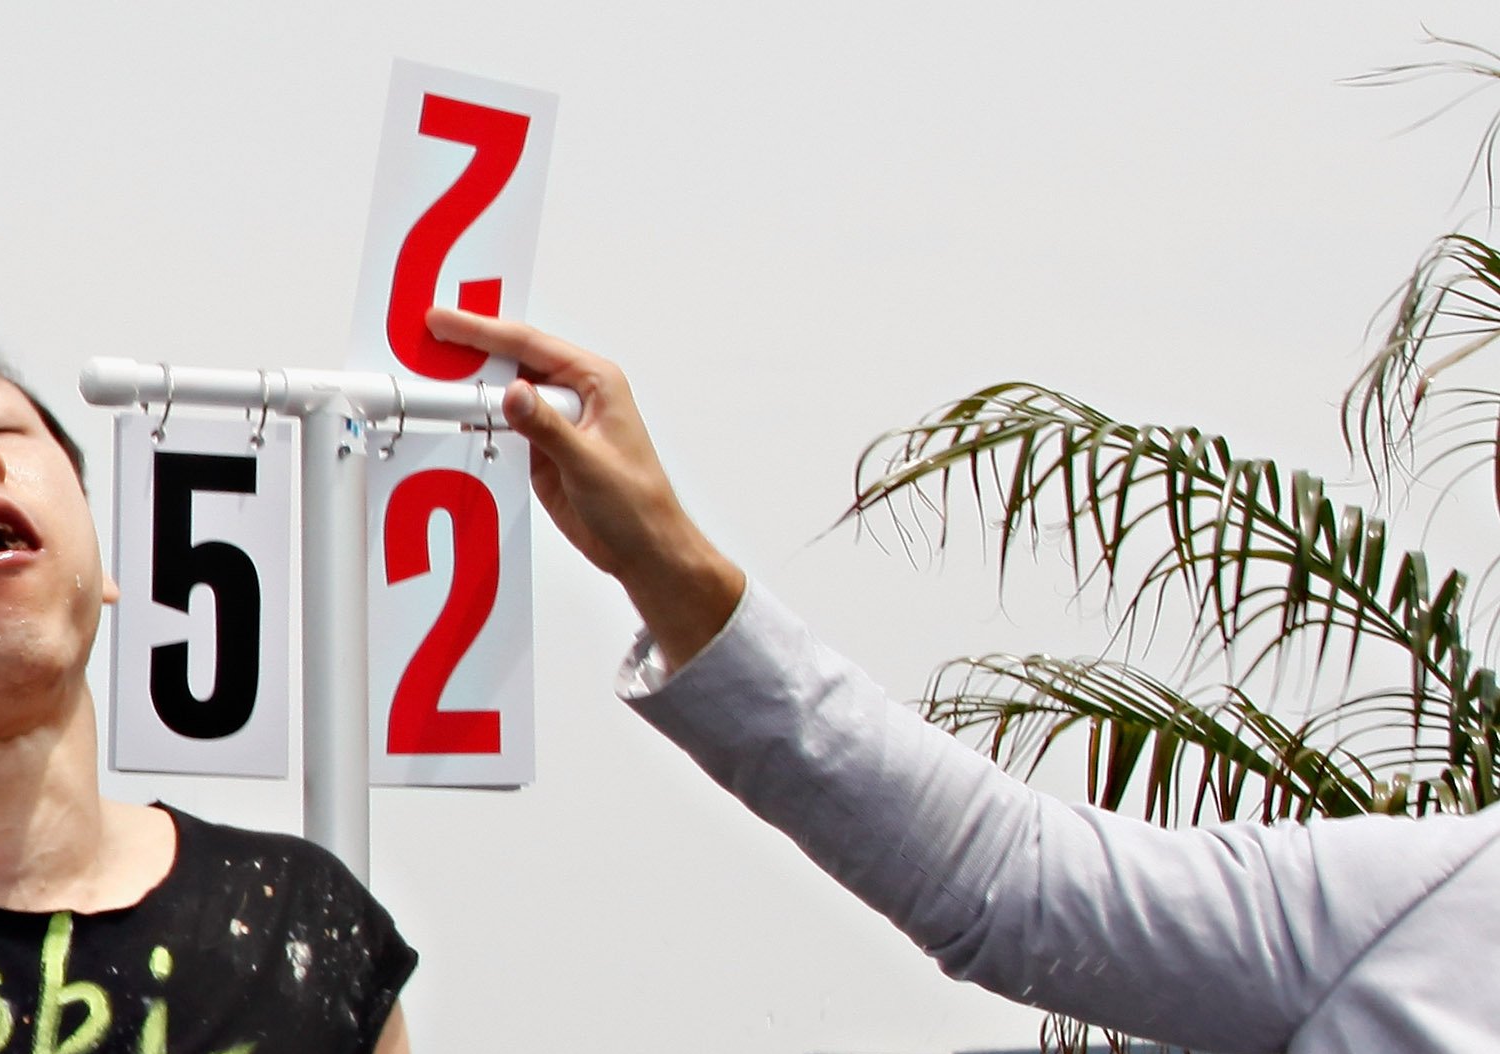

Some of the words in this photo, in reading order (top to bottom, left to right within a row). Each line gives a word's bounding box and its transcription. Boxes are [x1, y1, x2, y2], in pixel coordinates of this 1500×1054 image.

[387, 92, 531, 381] 2
[149, 452, 261, 740] 5
[384, 469, 501, 755] 2
